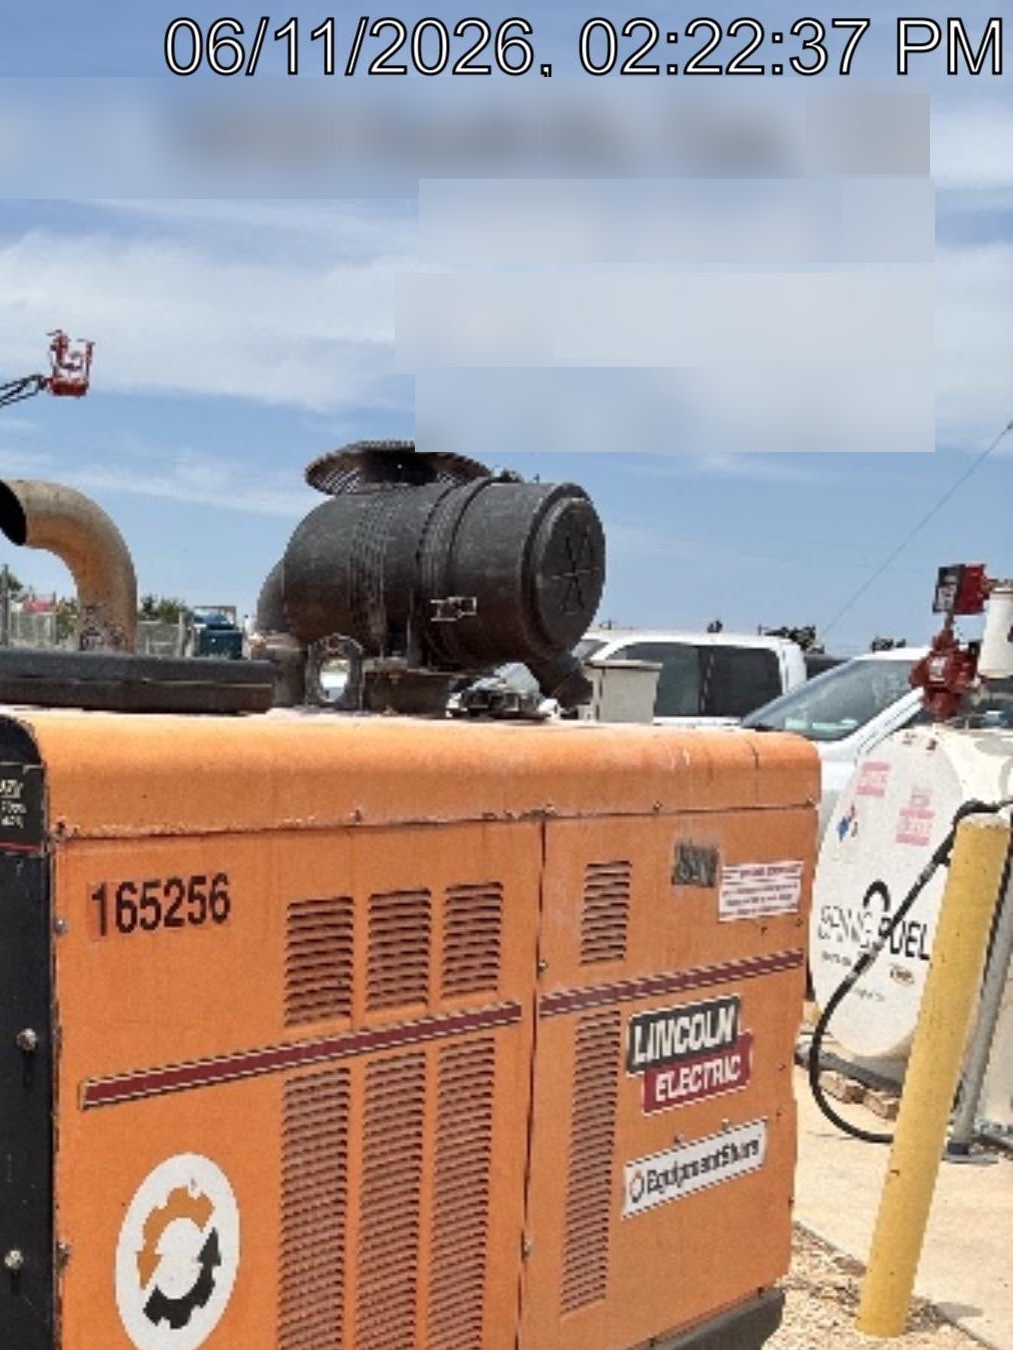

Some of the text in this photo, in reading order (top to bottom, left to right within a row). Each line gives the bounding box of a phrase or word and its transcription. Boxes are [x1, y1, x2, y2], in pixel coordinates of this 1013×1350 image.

[91, 872, 231, 937] 165256
[633, 1004, 736, 1065] LINCOLN
[655, 1054, 741, 1102] ELECTRIC
